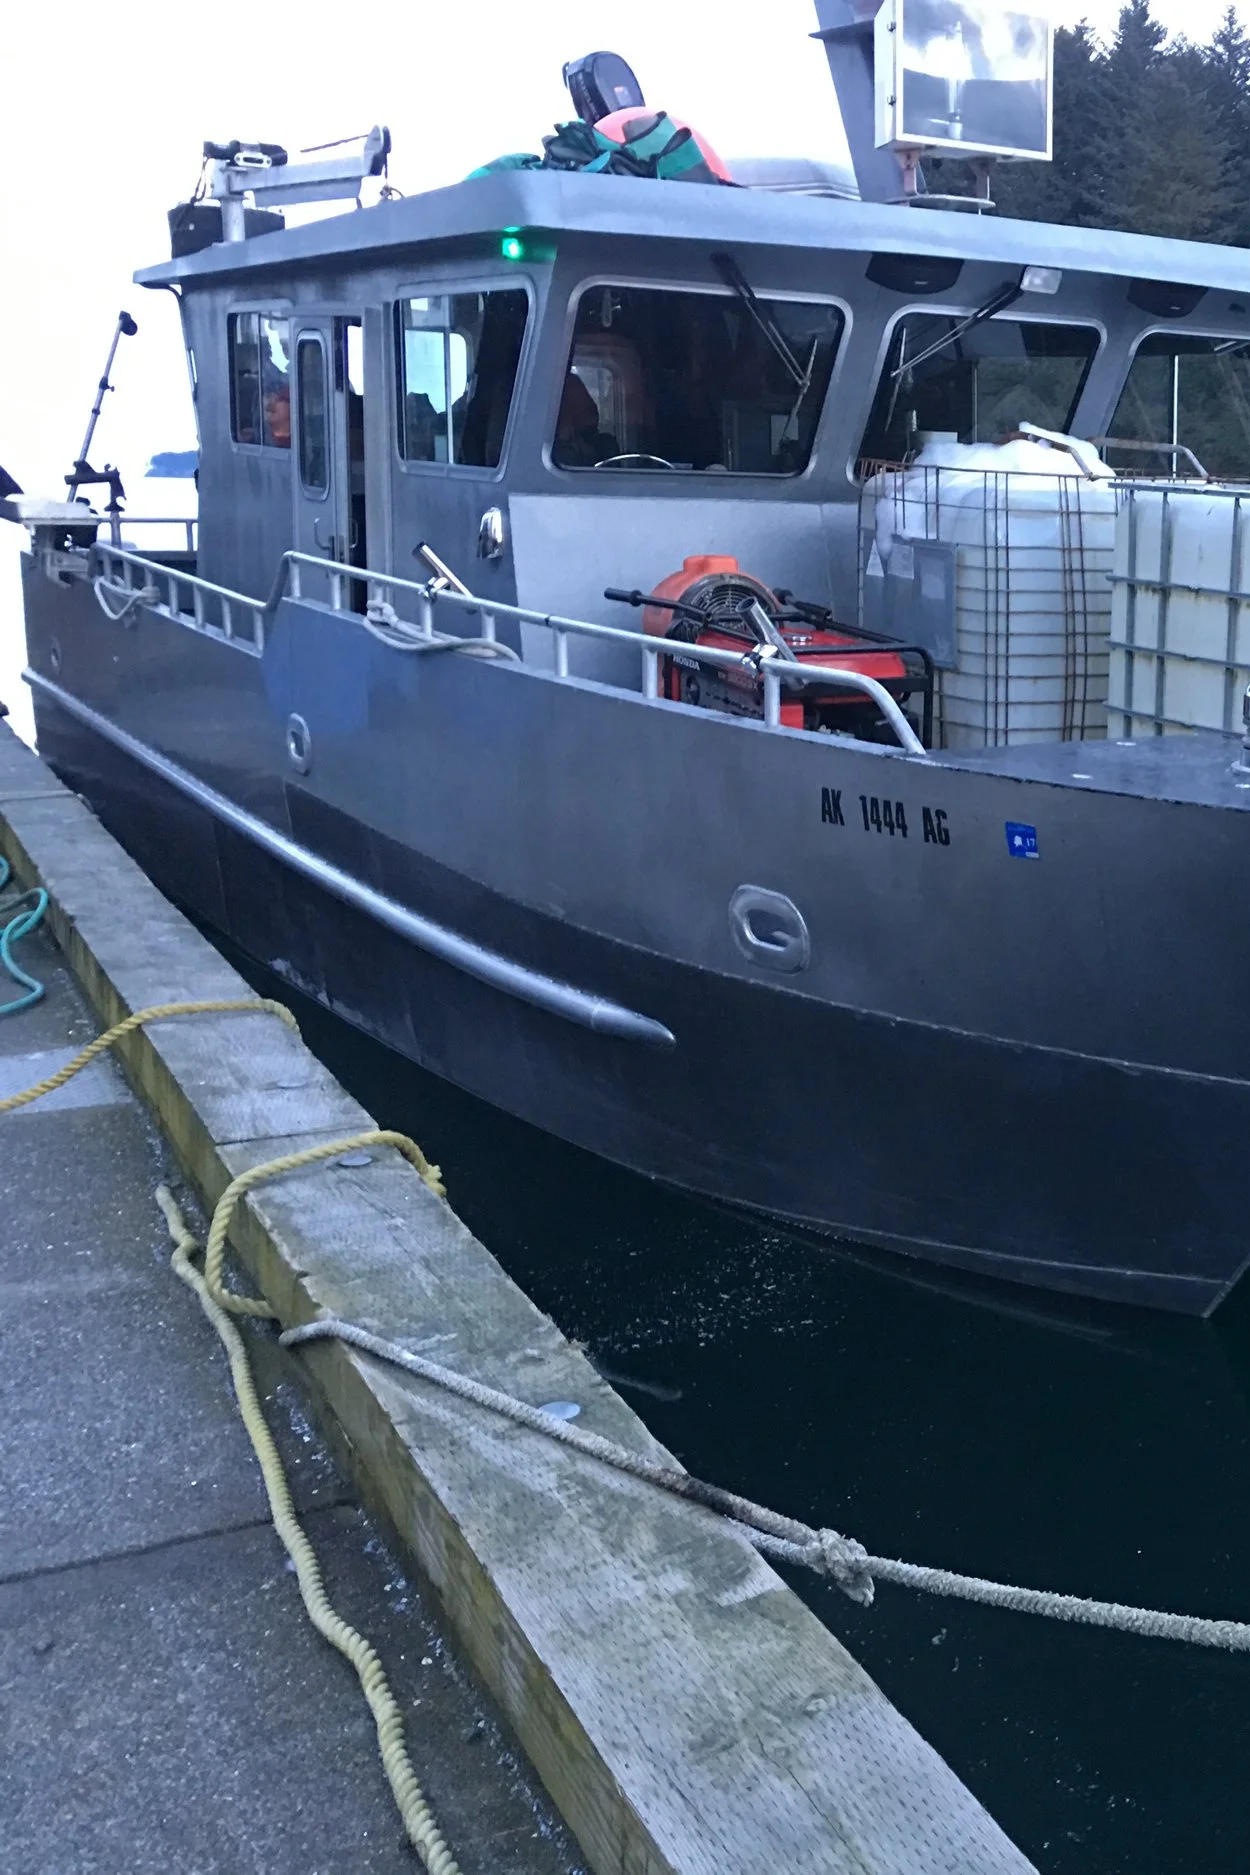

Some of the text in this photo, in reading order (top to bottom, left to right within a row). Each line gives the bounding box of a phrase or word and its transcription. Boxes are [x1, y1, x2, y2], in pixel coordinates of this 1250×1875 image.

[673, 653, 700, 671] HONDA
[821, 787, 951, 846] AK 1444 AG
[1026, 837, 1035, 847] 17
